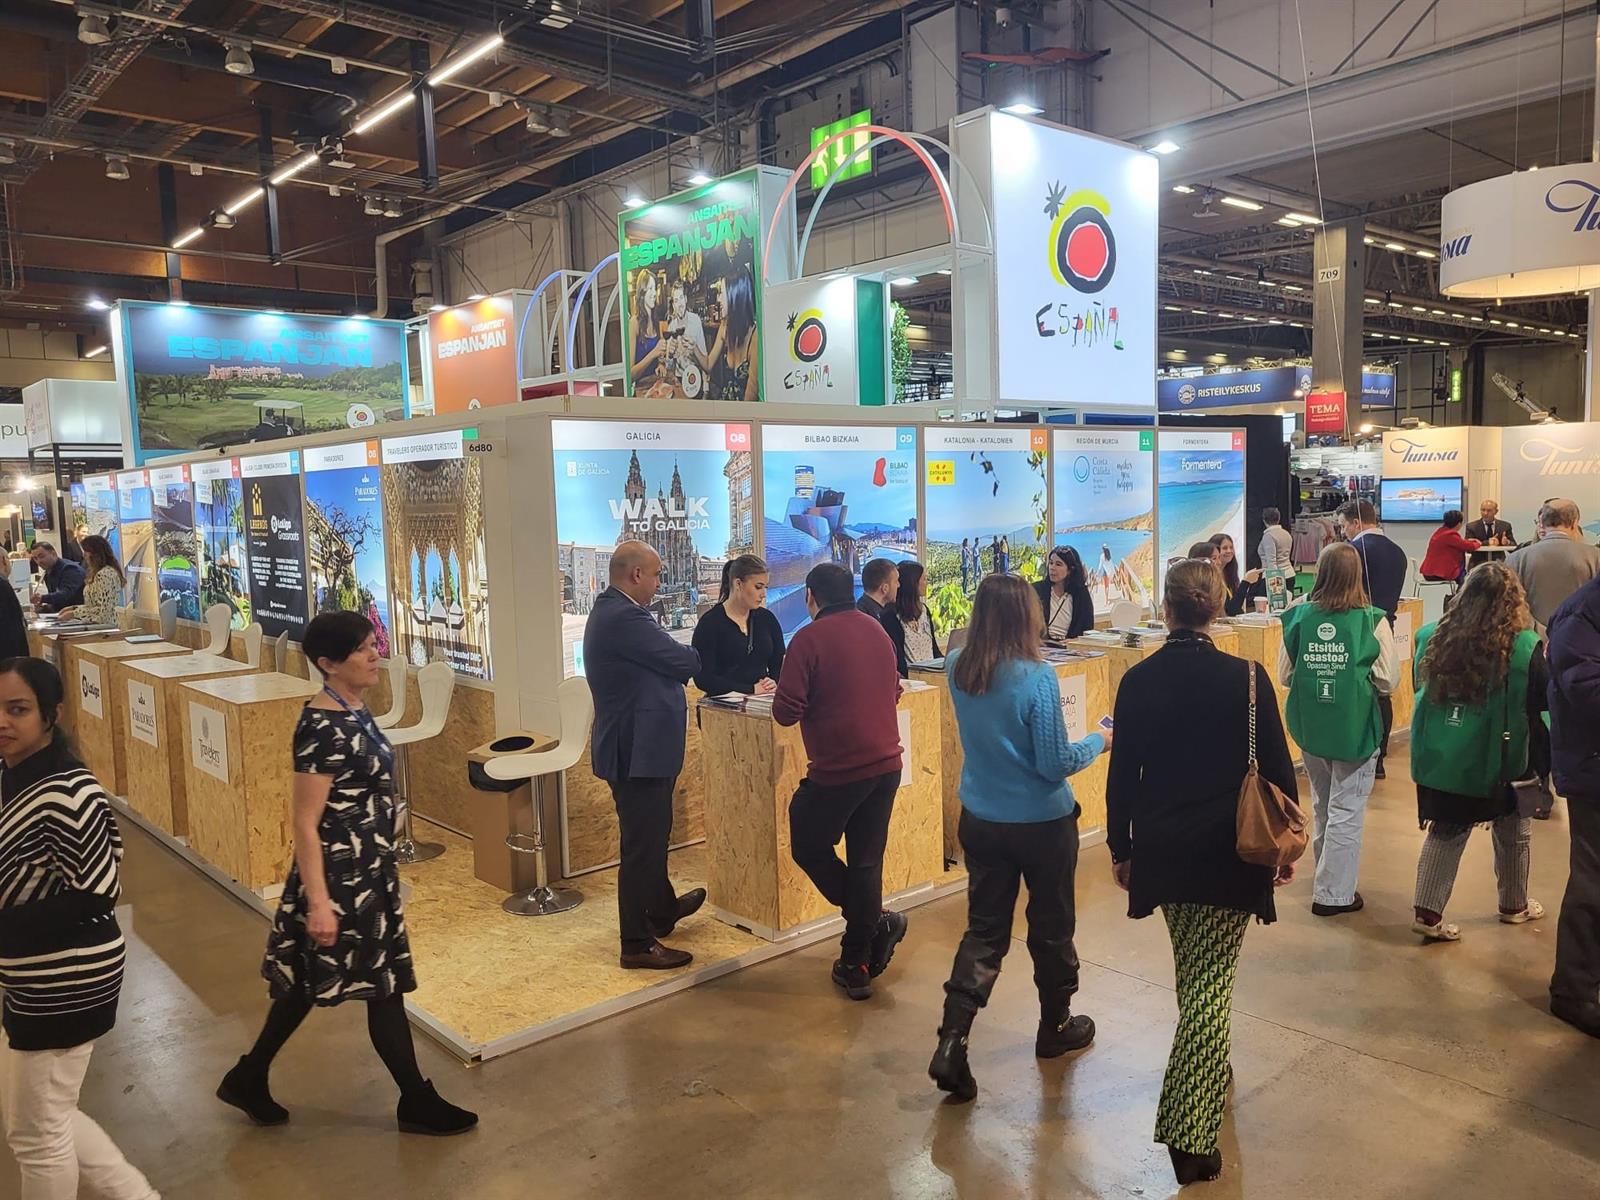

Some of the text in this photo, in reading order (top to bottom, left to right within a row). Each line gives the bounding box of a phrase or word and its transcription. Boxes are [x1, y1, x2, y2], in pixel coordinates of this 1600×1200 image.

[622, 213, 755, 271] ESPANJAN
[1320, 269, 1338, 280] 709
[438, 329, 507, 359] ESPANJAN
[167, 335, 374, 368] ESPANJAN
[1198, 383, 1261, 398] RISTEILYKESKUS
[1309, 403, 1341, 414] TEMA
[625, 432, 661, 441] GALICIA
[729, 433, 747, 444] 08
[804, 435, 860, 443] BILBAO BIZKAIA
[899, 434, 913, 444] 09
[1033, 436, 1044, 445] 10
[469, 443, 493, 453] 6d80
[1389, 438, 1459, 464] Tunisia
[608, 496, 711, 520] WALK
[629, 519, 711, 532] TO GALICIA
[1308, 642, 1345, 653] Etsitkö
[1303, 653, 1349, 663] osastoa?
[1306, 661, 1346, 671] Opastan Sinut
